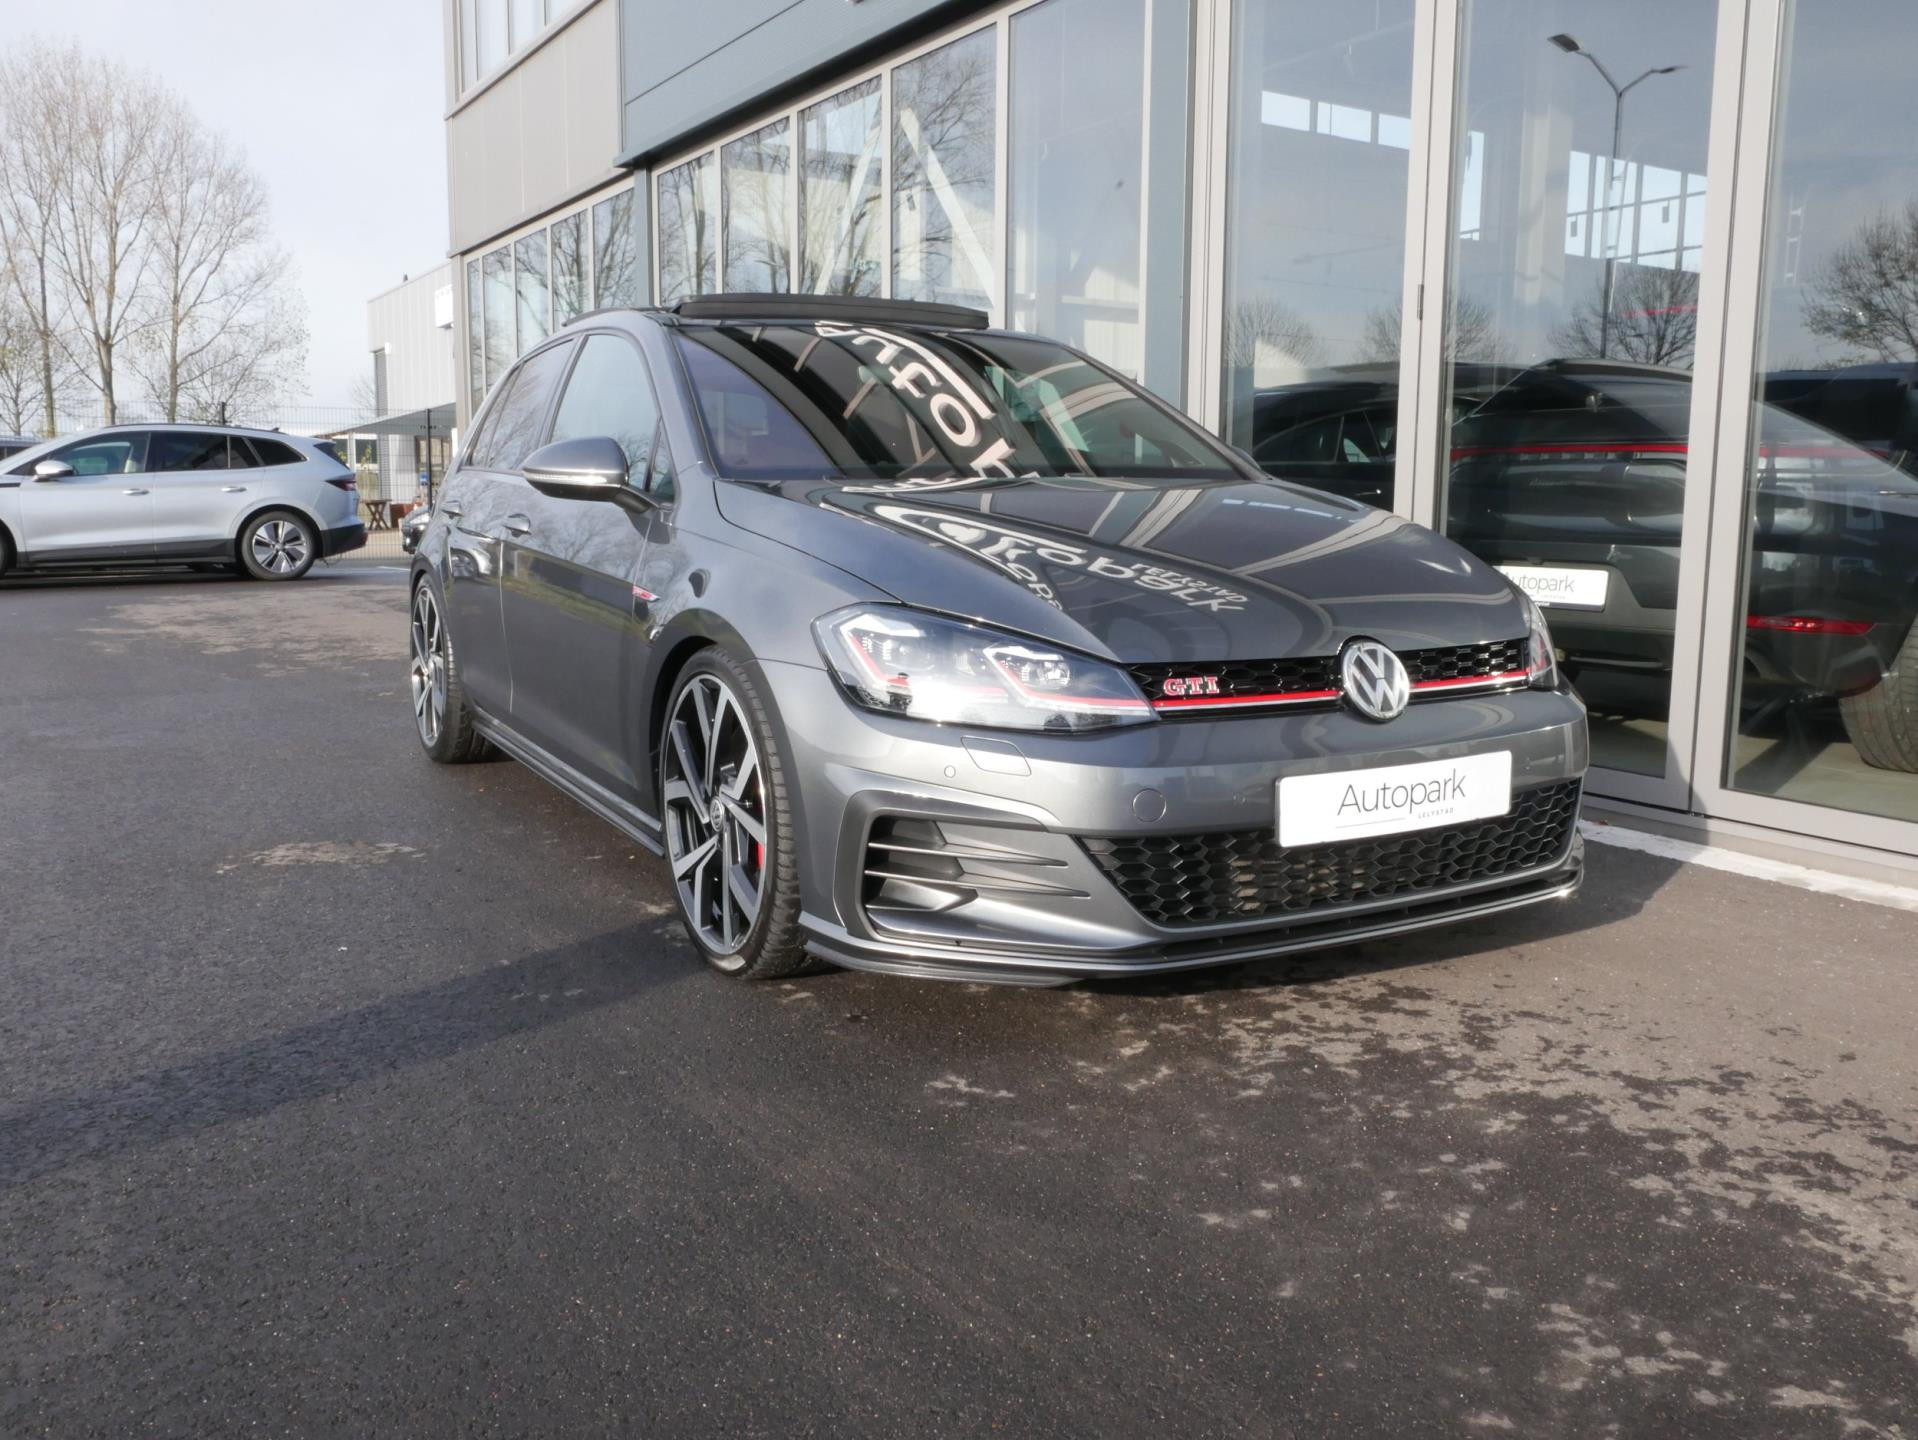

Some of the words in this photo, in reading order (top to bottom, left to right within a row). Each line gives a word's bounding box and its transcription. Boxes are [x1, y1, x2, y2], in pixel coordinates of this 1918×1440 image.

[1506, 572, 1576, 595] topark
[1163, 676, 1220, 696] GTI
[1346, 643, 1407, 718] VW
[1337, 768, 1466, 816] Autopark
